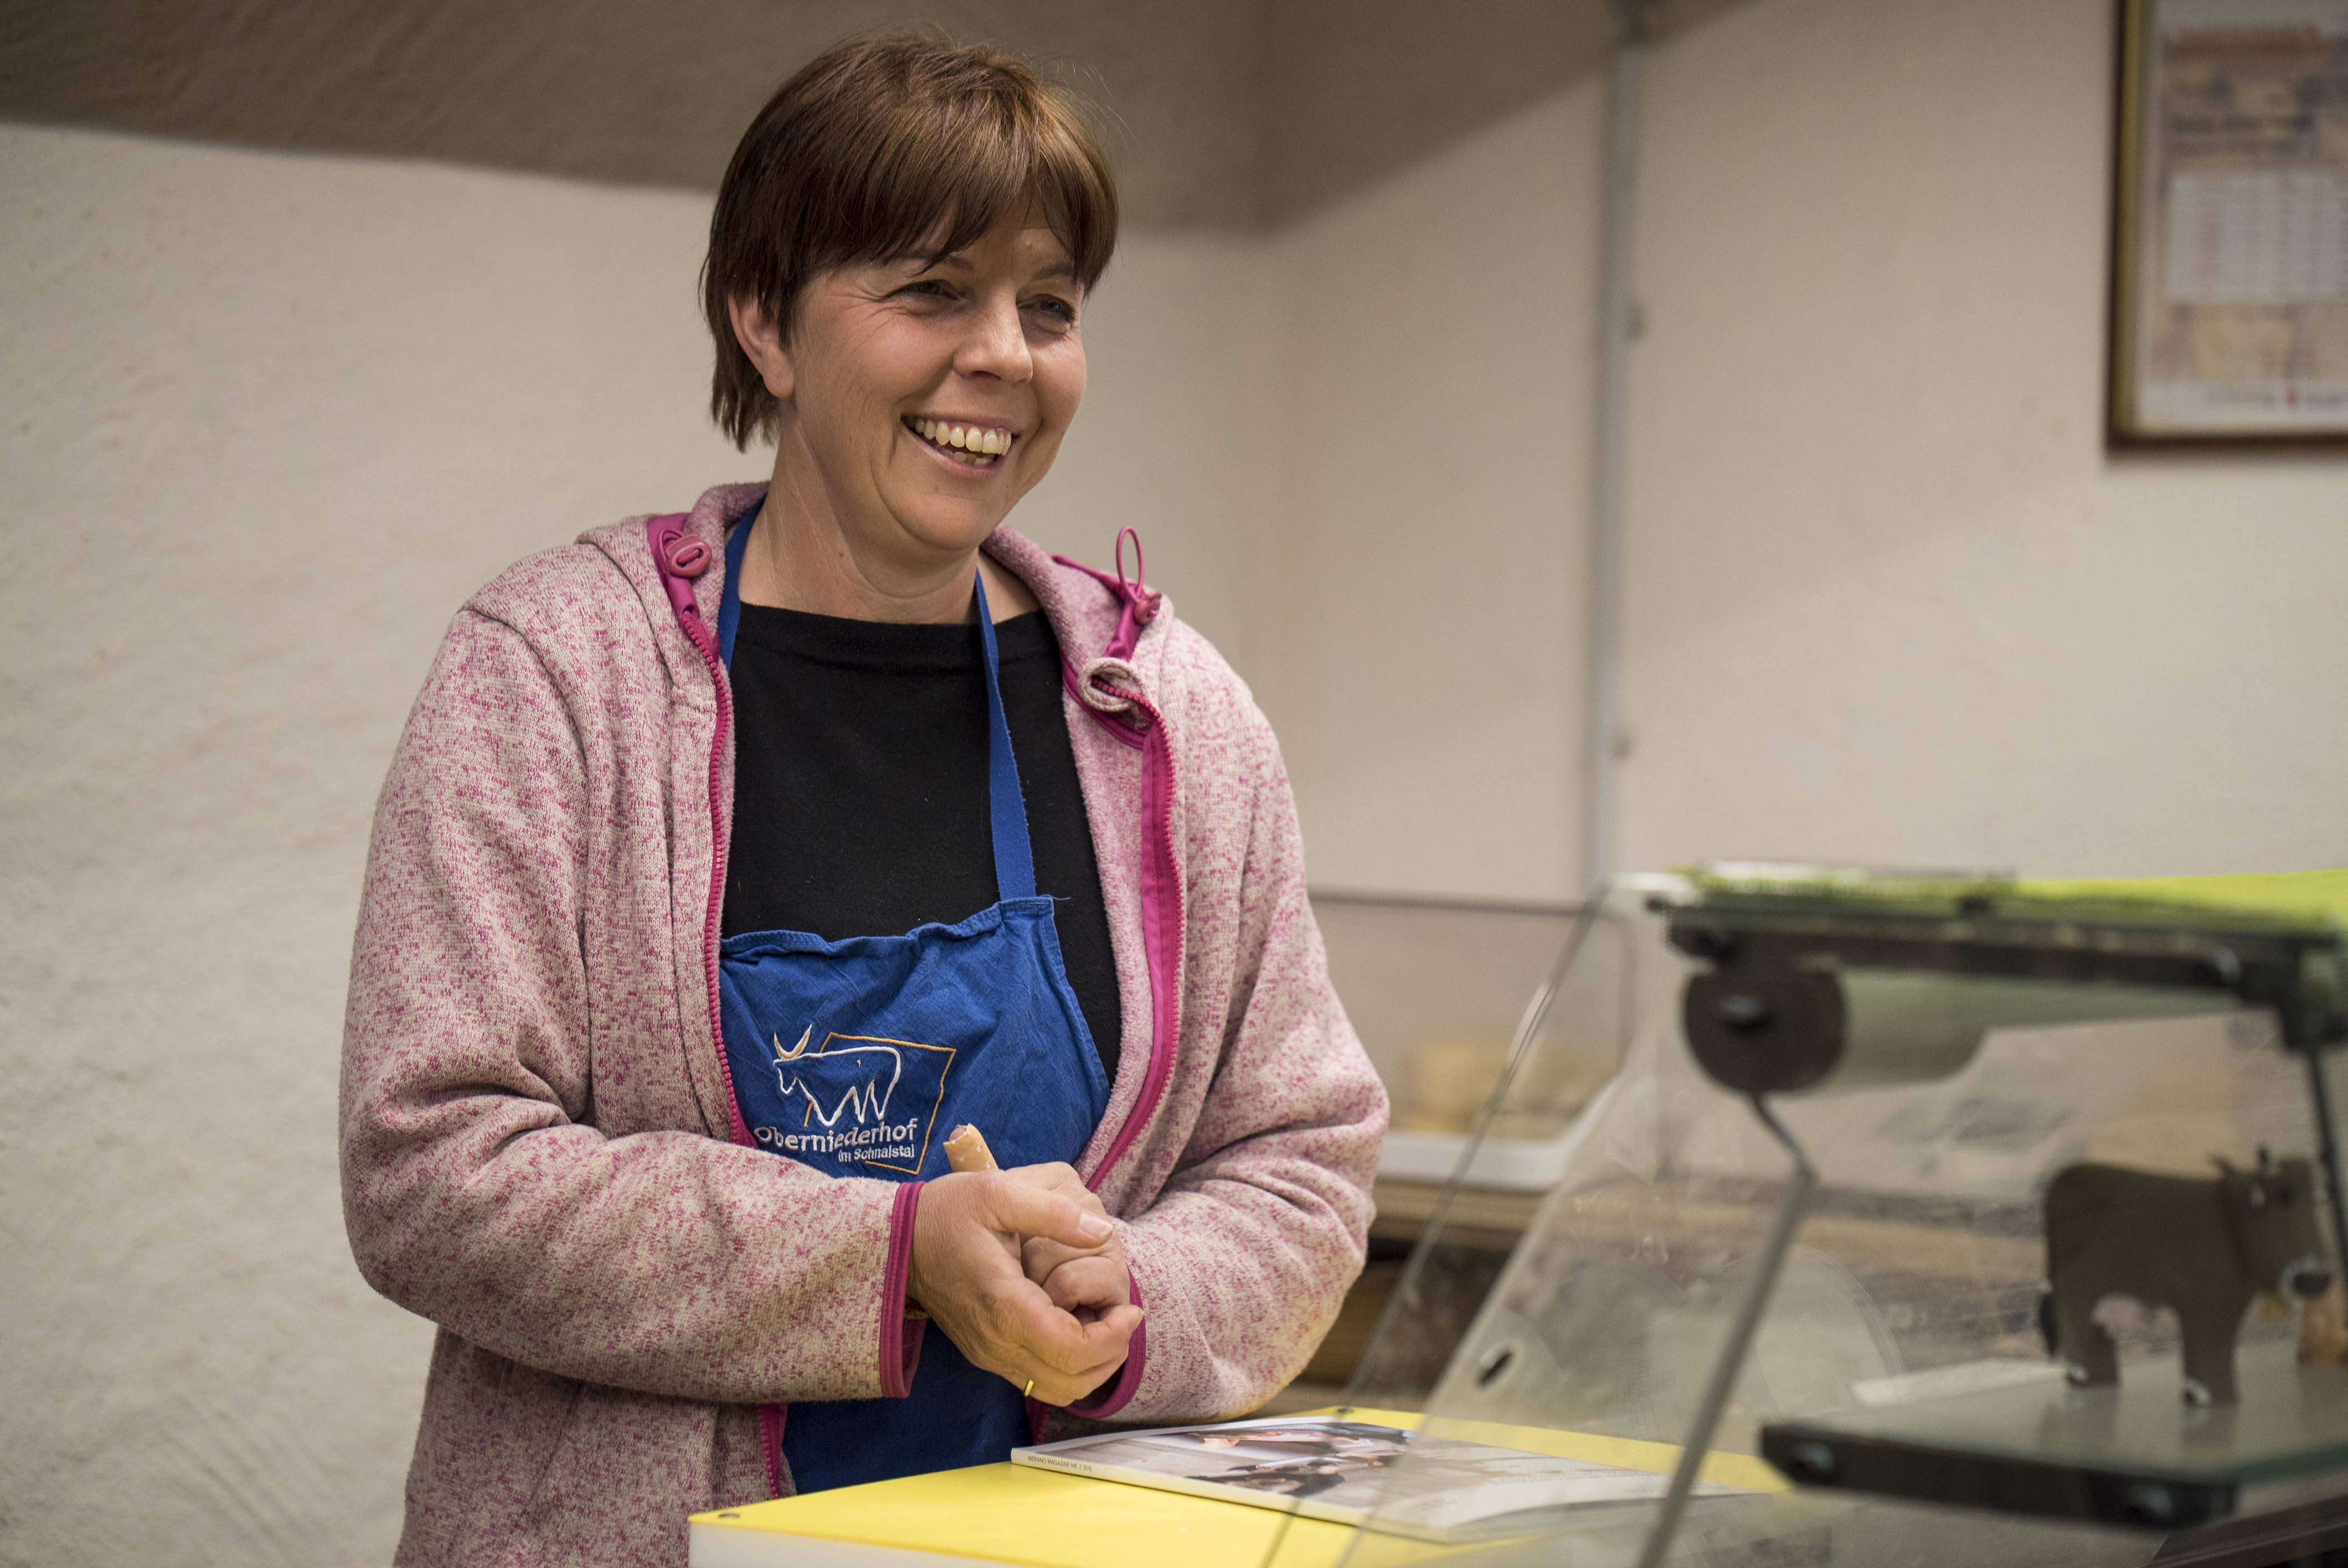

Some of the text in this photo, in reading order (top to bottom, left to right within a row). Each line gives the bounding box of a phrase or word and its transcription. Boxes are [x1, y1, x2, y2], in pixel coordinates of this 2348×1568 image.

[754, 1118, 918, 1153] Oberniederhof
[838, 1144, 915, 1162] im Schnalstal
[1028, 1455, 1047, 1464] MERANO
[1047, 1458, 1069, 1468] MAGAZINE
